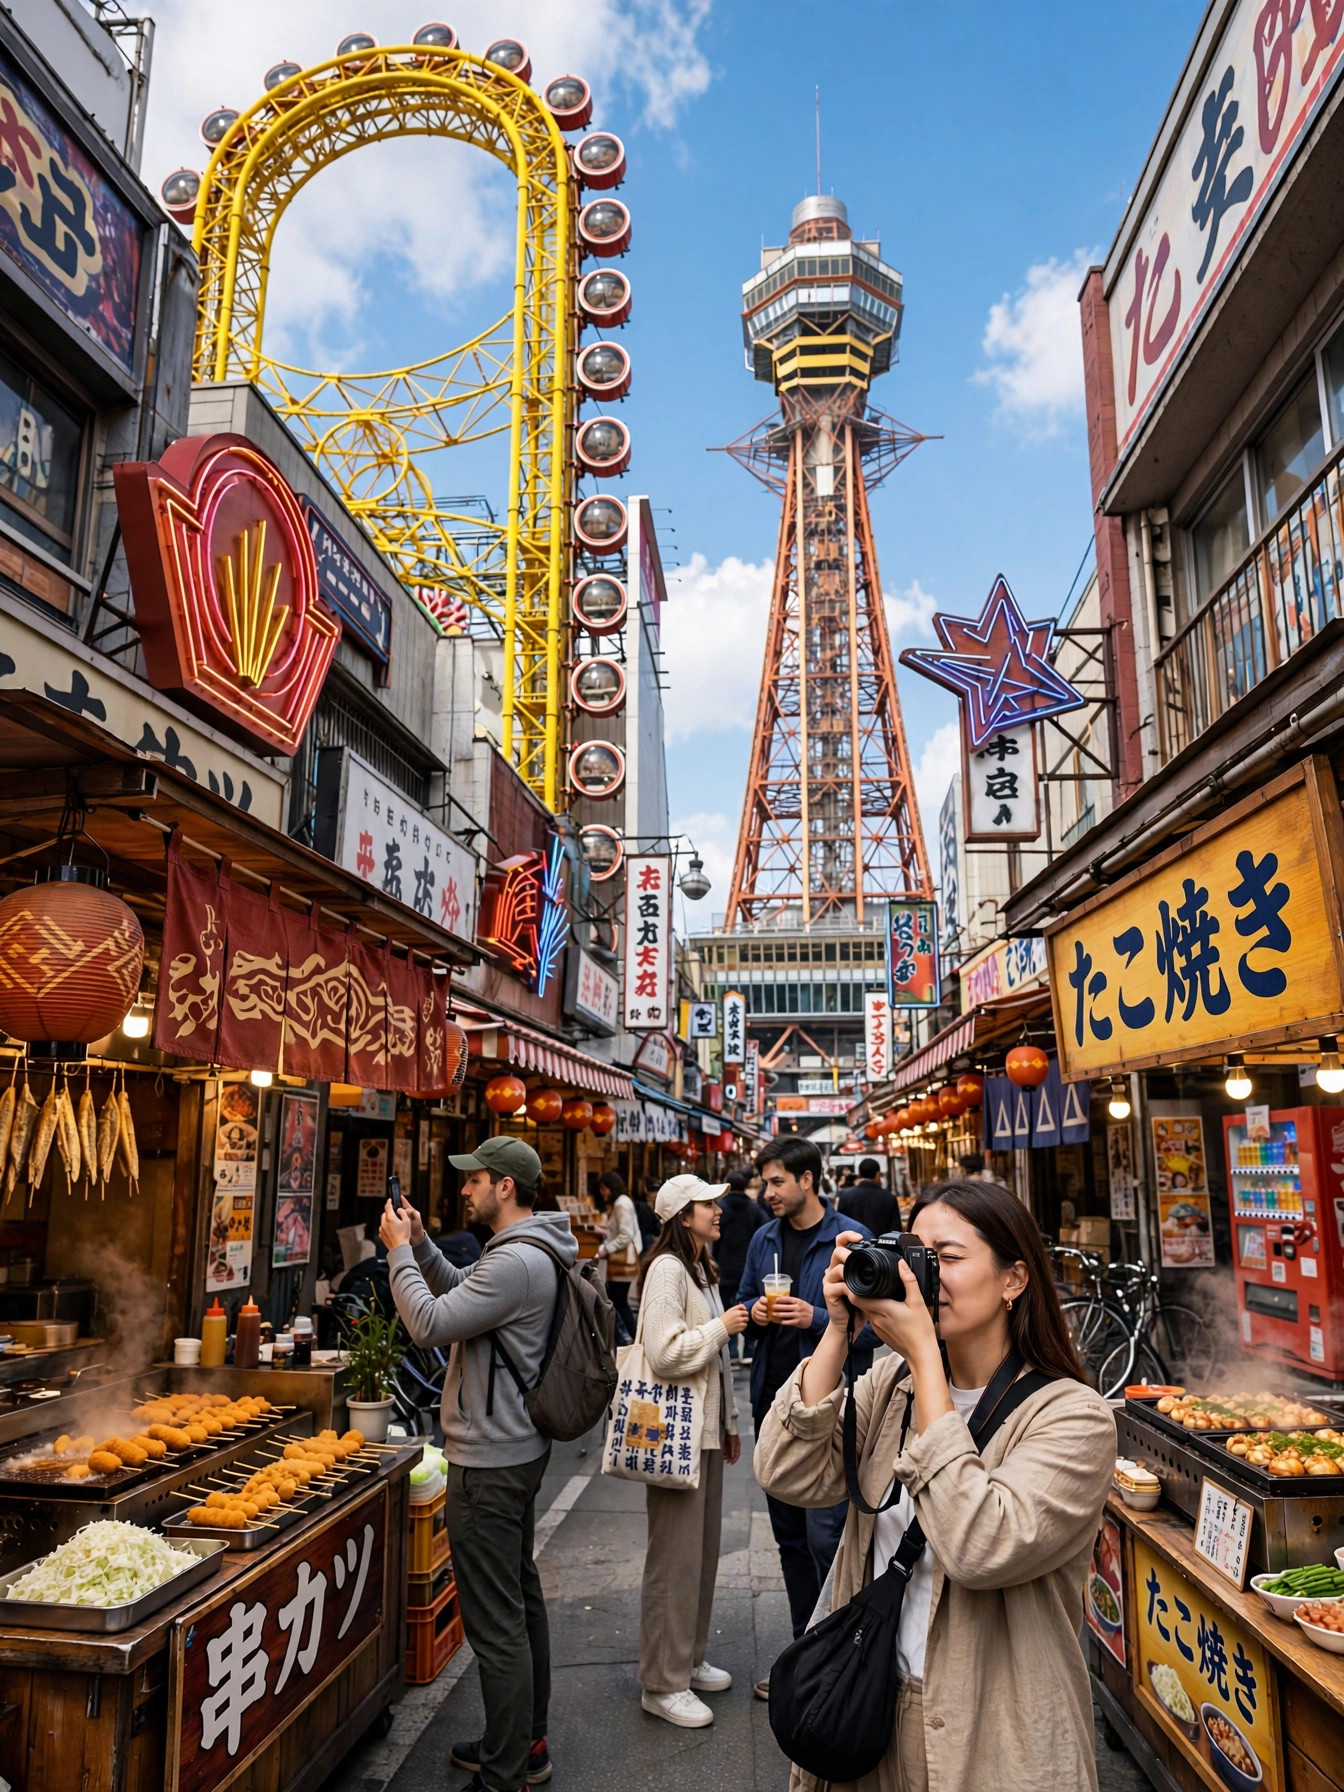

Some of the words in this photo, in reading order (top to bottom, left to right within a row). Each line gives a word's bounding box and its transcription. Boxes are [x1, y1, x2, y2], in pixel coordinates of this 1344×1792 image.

[1069, 850, 1292, 1047] たこ焼き
[200, 1524, 375, 1756] 串カツ
[1146, 1568, 1258, 1725] たこ焼き
